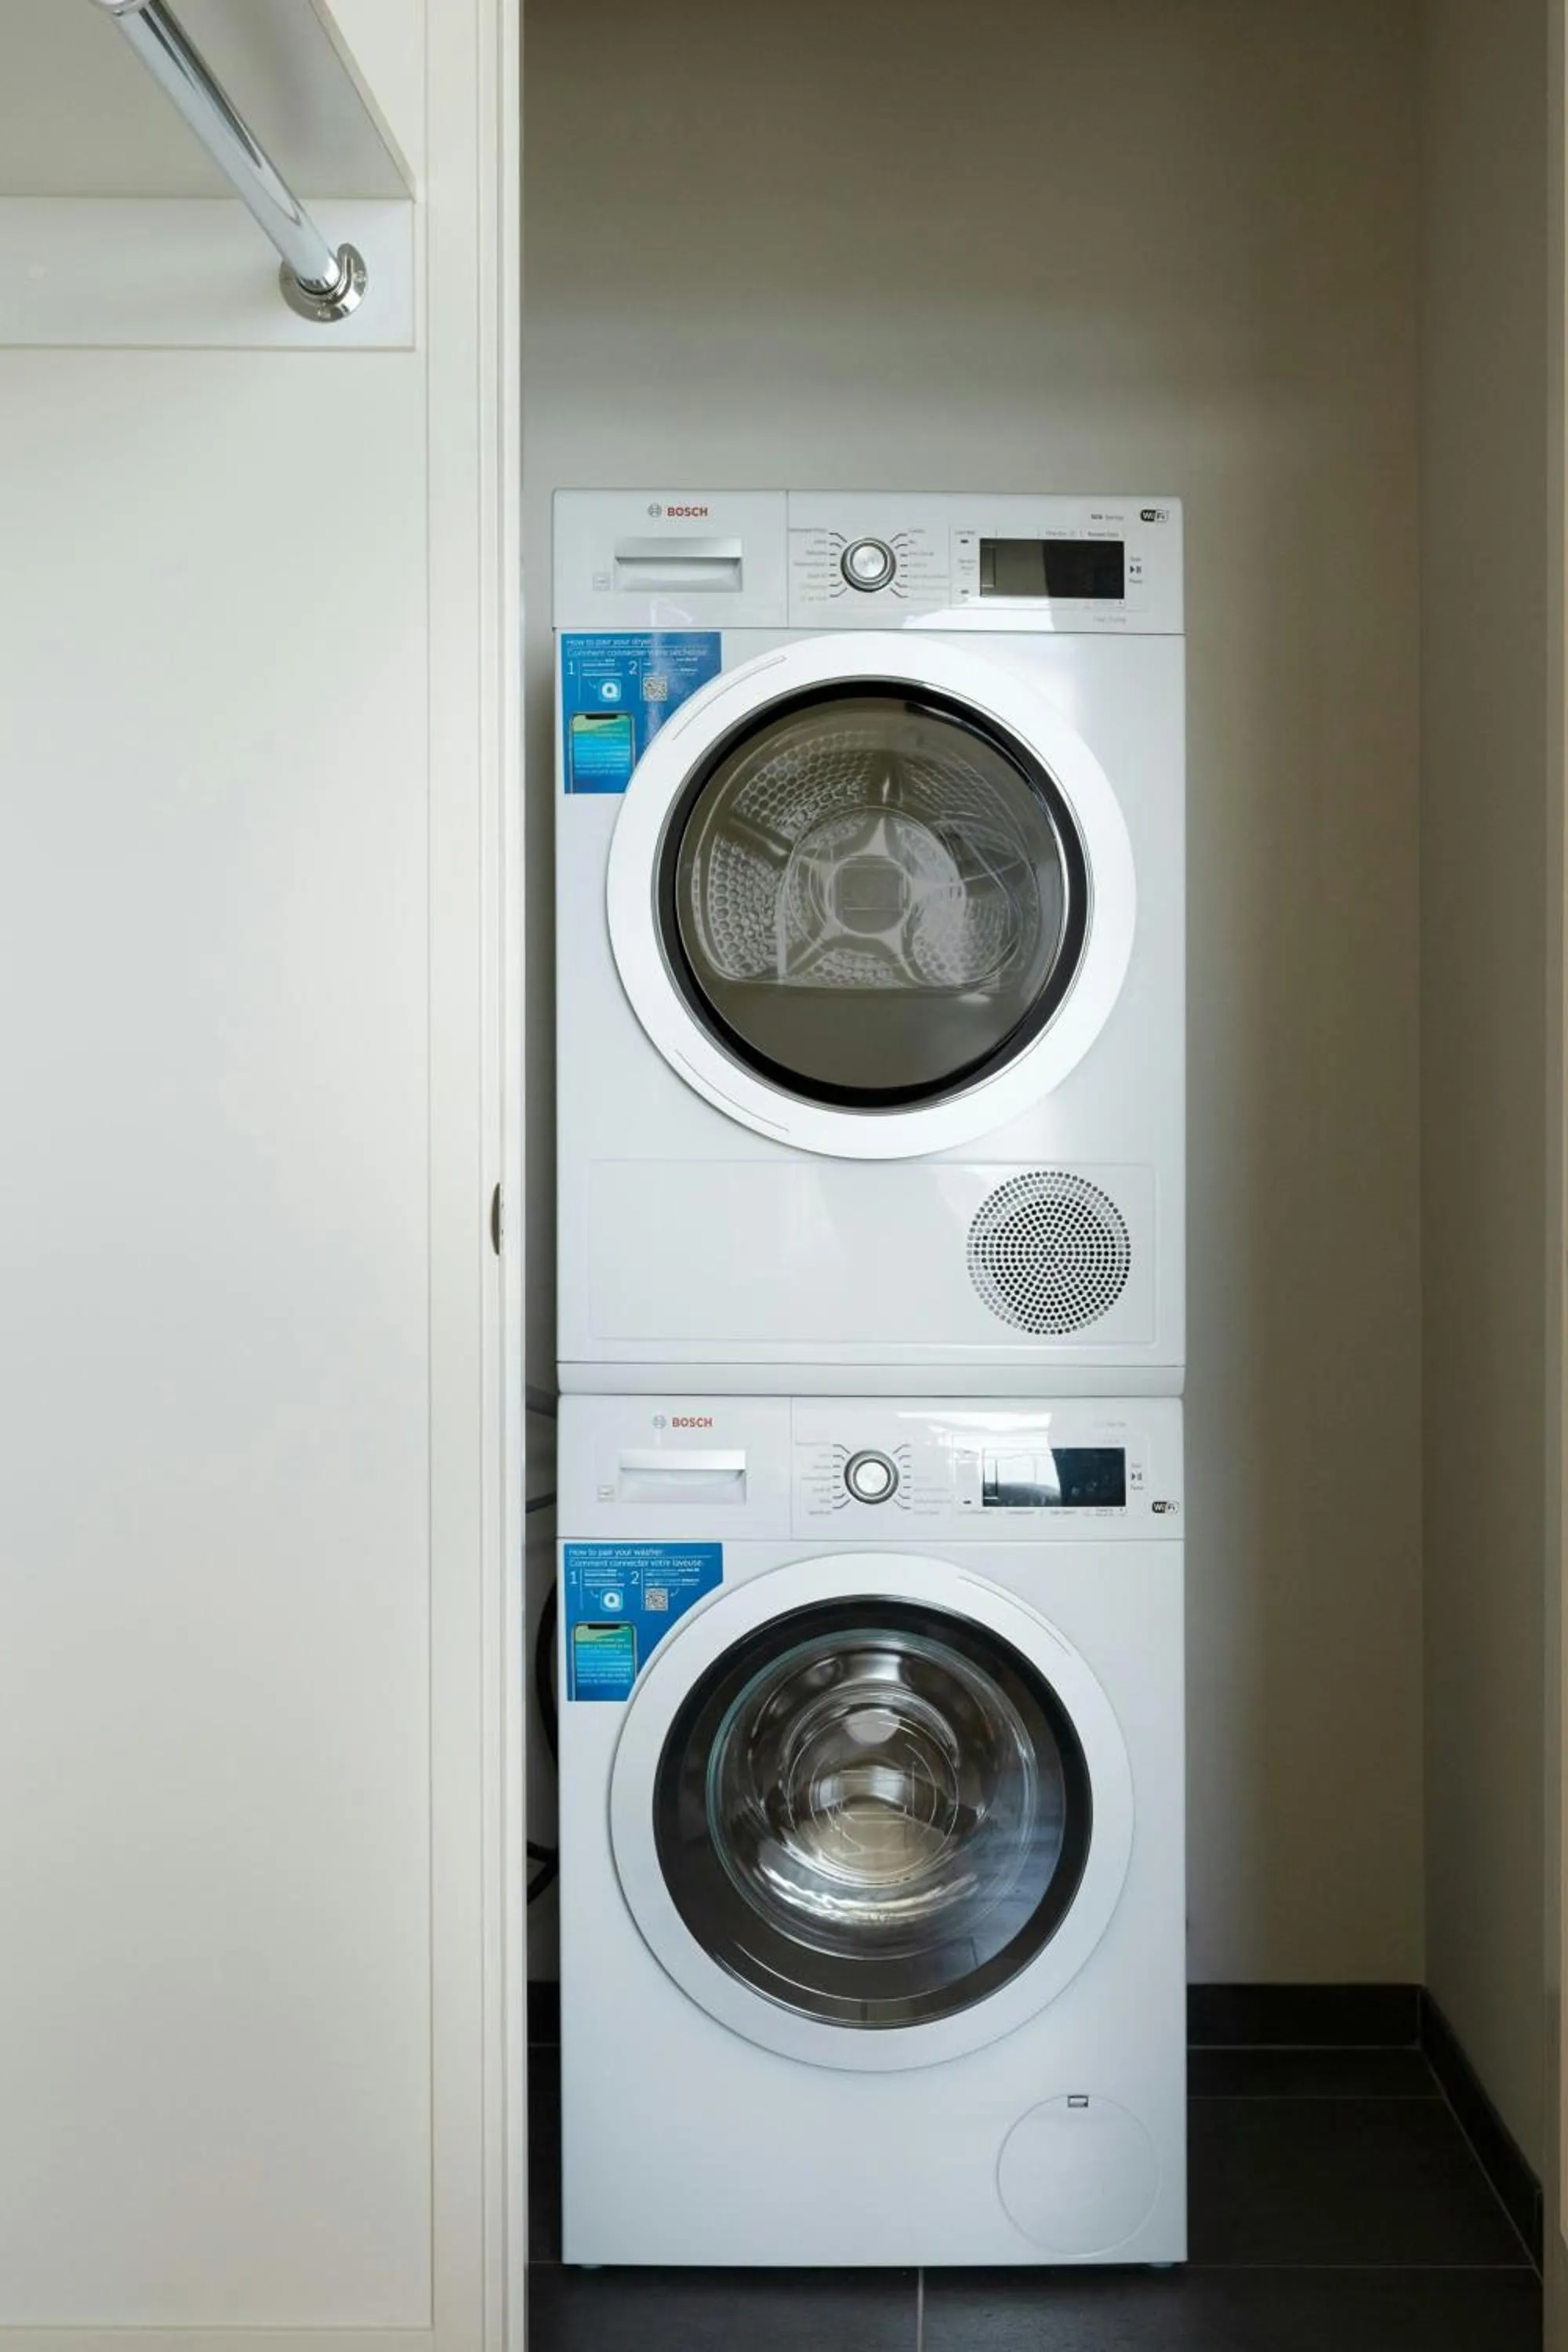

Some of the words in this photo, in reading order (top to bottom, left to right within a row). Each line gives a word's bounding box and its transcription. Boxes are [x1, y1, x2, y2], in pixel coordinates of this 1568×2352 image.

[667, 506, 709, 517] BOSCH
[568, 661, 575, 675] 1
[629, 661, 638, 675] 2
[672, 1417, 713, 1428] BOSCH
[570, 1571, 578, 1584] 1
[630, 1571, 639, 1584] 2
